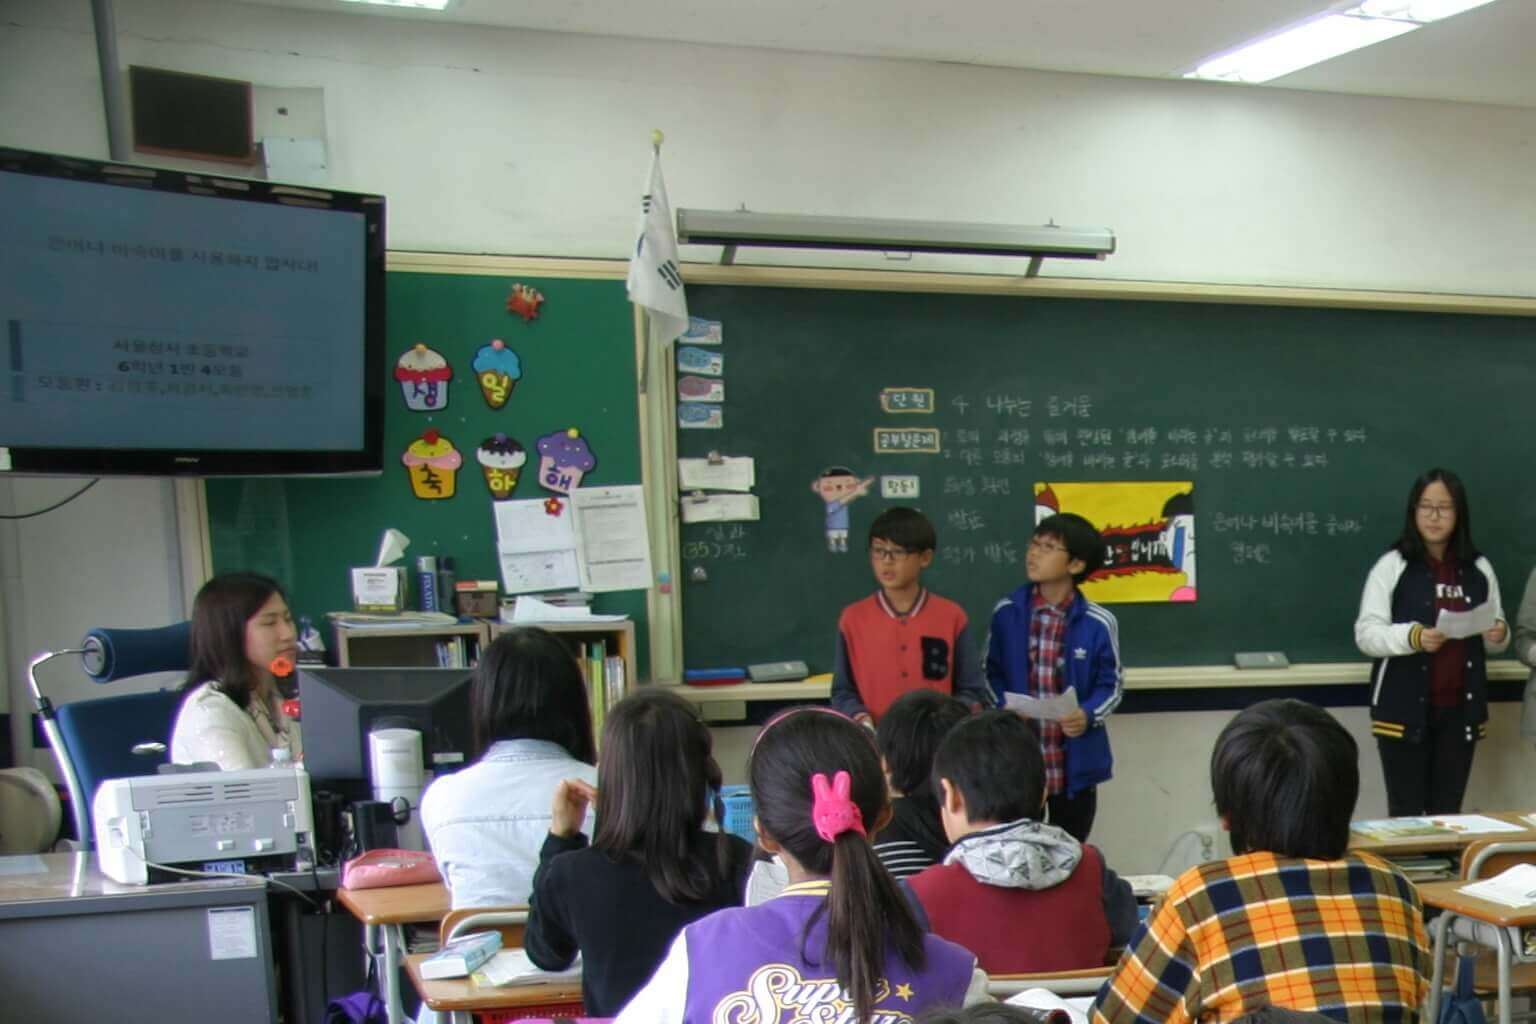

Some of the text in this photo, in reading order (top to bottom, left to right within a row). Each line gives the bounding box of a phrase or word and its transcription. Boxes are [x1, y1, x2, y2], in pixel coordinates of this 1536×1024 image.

[481, 371, 509, 402] 일
[986, 396, 1032, 417] 나누는
[1046, 395, 1094, 417] 즐거움
[419, 463, 573, 495] 축 하 해
